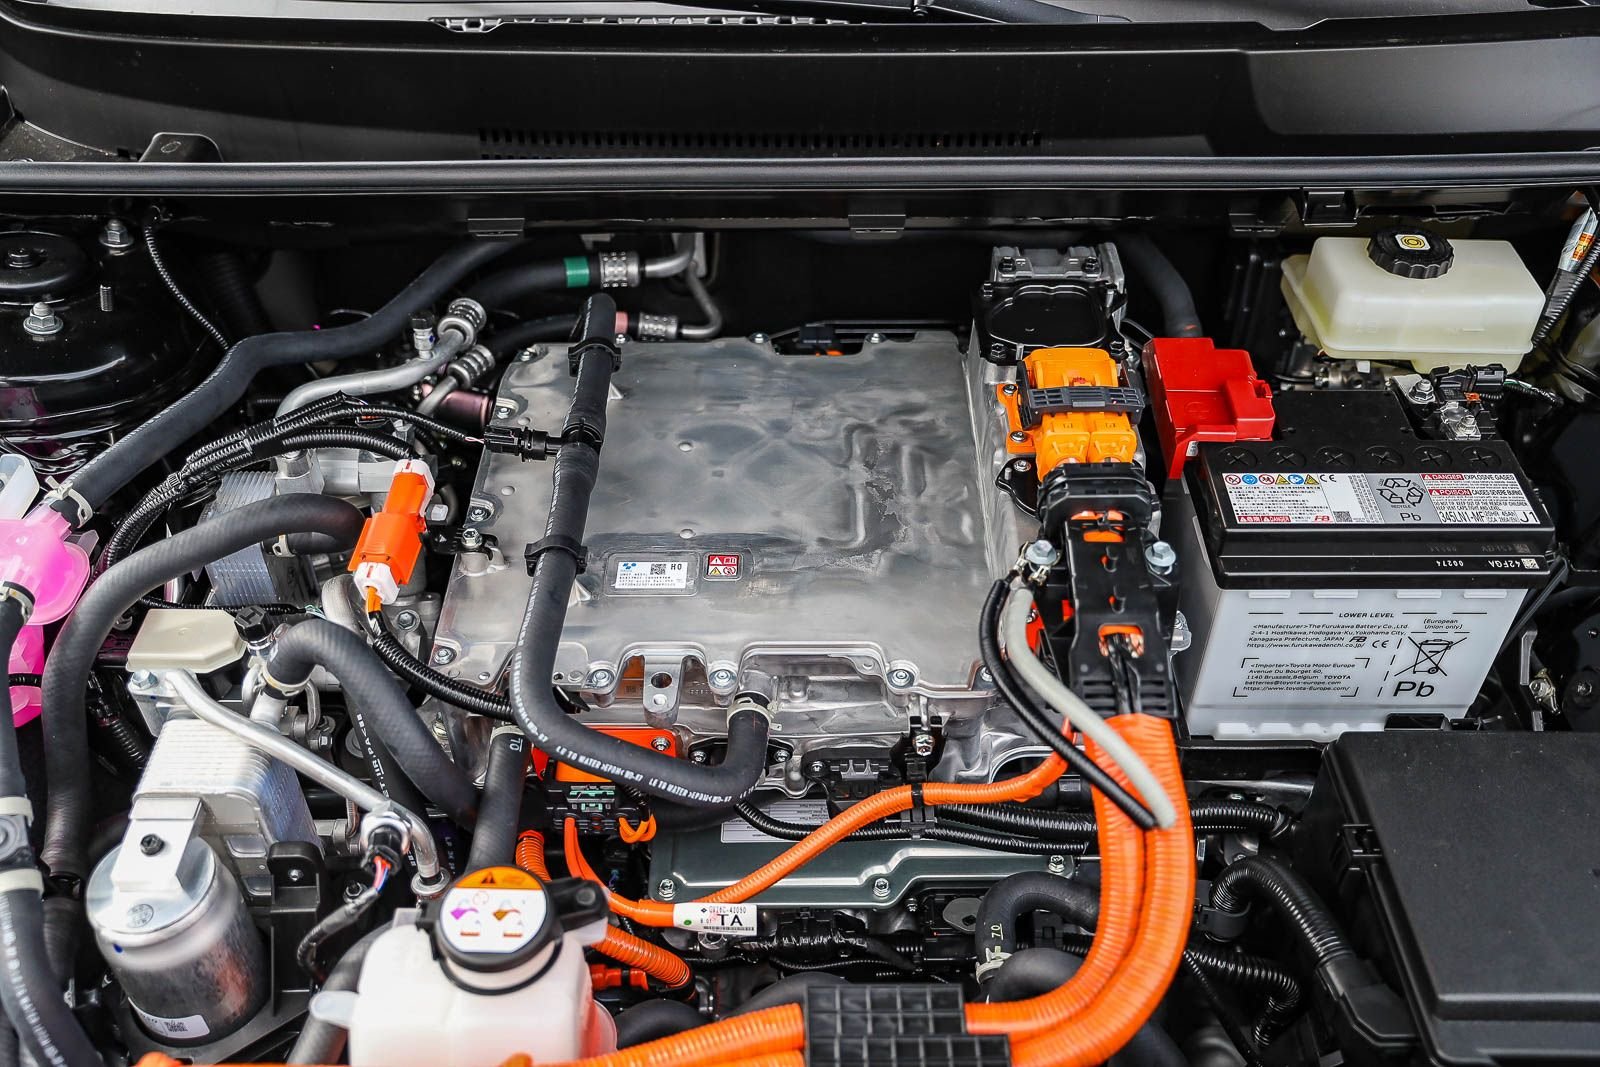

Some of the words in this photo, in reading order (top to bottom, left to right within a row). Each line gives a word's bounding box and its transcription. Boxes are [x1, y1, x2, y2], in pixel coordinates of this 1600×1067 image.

[1400, 512, 1422, 522] Pb
[1393, 681, 1435, 698] Pb
[510, 738, 521, 751] 70
[578, 755, 602, 769] WATER
[666, 783, 688, 797] WATER
[717, 913, 743, 926] TA
[990, 924, 1001, 939] 70
